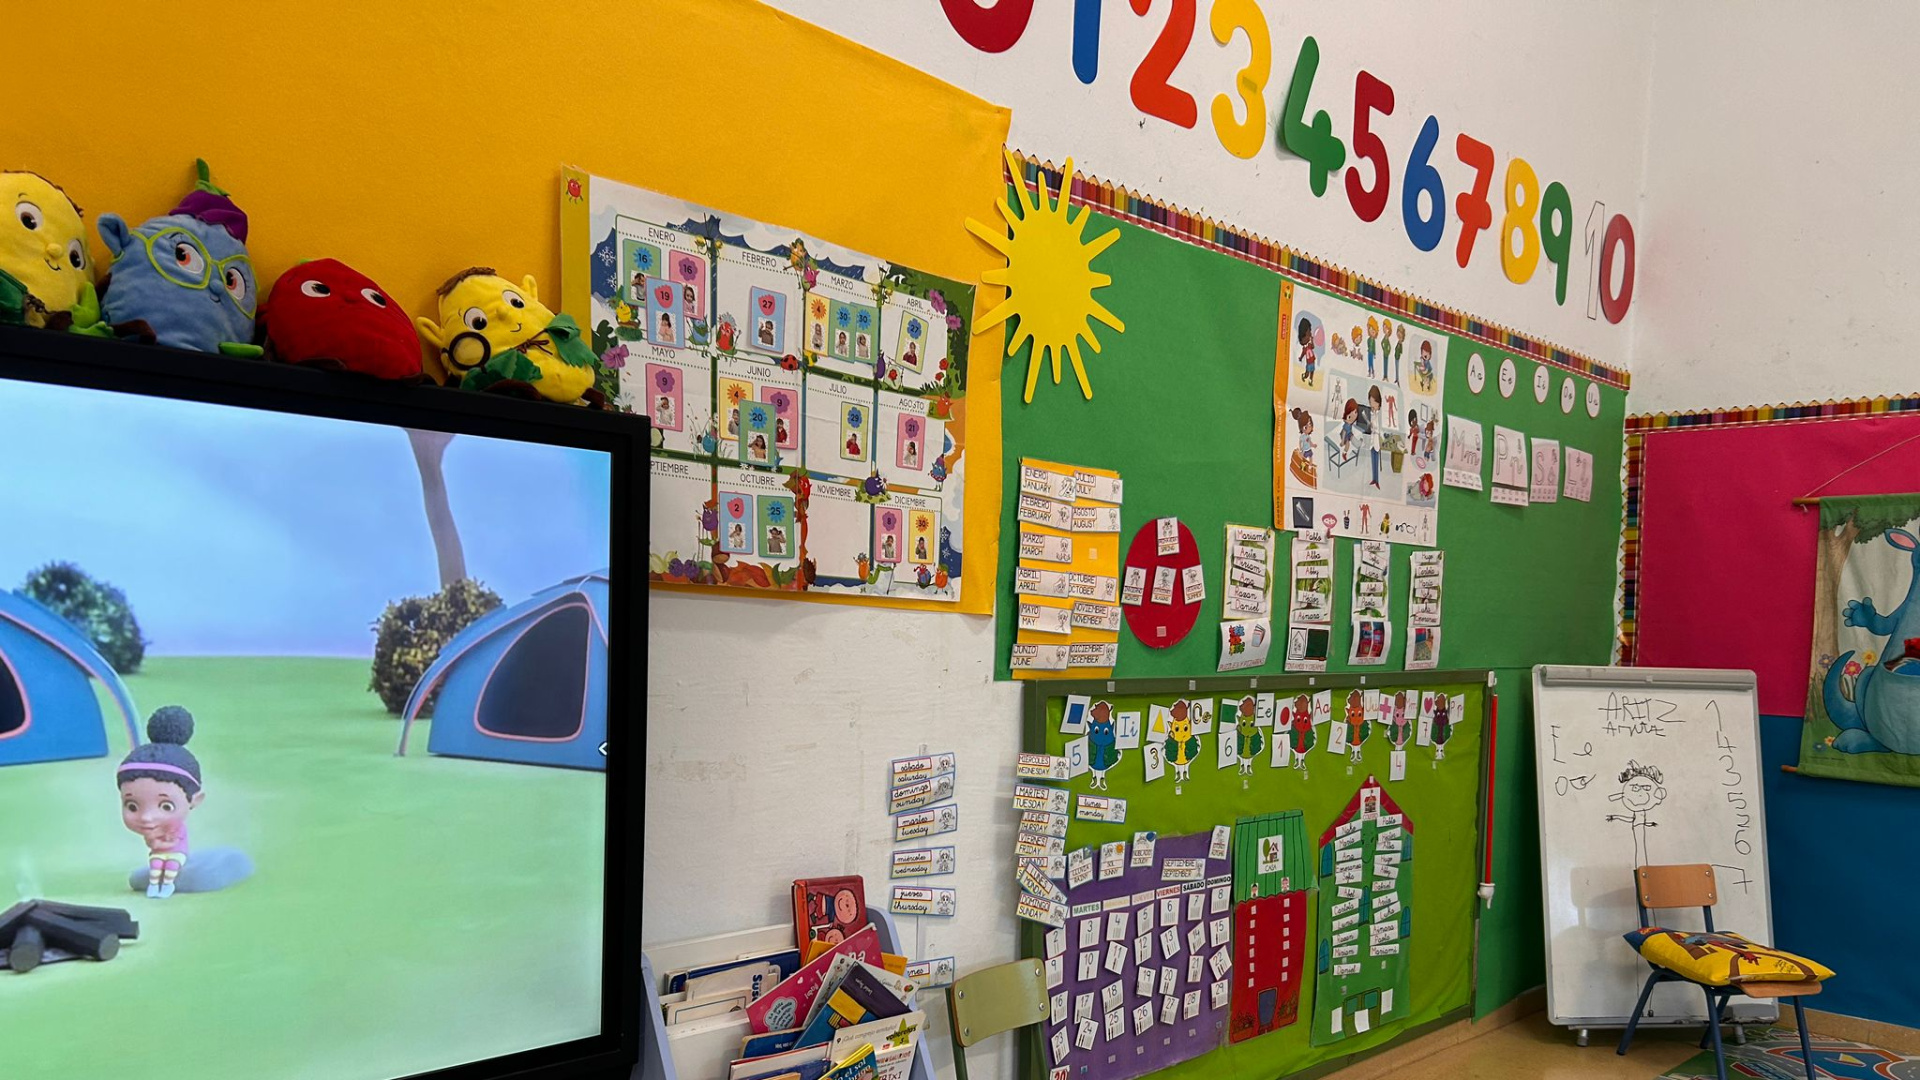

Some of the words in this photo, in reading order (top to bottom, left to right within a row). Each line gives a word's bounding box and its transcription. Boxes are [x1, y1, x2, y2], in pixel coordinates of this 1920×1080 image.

[1130, 0, 1198, 128] 2
[1210, 0, 1272, 158] 3
[1283, 36, 1346, 197] 4
[1345, 70, 1395, 222] 5
[1402, 115, 1446, 251] 6
[1455, 133, 1495, 267] 7
[1500, 157, 1540, 284] 8
[1540, 181, 1573, 305] 9
[1583, 200, 1635, 324] 10
[648, 228, 676, 243] ENERO
[637, 253, 649, 265] 16
[742, 251, 777, 268] FEBRERO
[682, 263, 694, 275] 16
[830, 276, 854, 290] MARZO
[660, 290, 671, 302] 19
[762, 299, 773, 311] 27
[906, 298, 924, 310] ABRIL
[815, 305, 822, 316] 4
[838, 311, 849, 323] 30
[858, 313, 868, 325] 30
[911, 323, 920, 334] 27
[651, 346, 676, 359] MAYO
[746, 366, 771, 378] JUNIO
[661, 376, 668, 387] 9
[734, 390, 740, 401] 4
[829, 384, 847, 395] JULIO
[776, 397, 783, 409] 9
[899, 398, 925, 411] AGOSTO
[752, 412, 763, 424] 20
[851, 413, 860, 424] 29
[907, 423, 916, 433] 21
[650, 461, 689, 476] PTIEMBRE
[740, 474, 775, 487] OCTUBRE
[1025, 469, 1047, 481] ENERO
[1075, 472, 1095, 483] JULIO
[817, 484, 852, 498] NOVIEMBRE
[1023, 480, 1051, 493] JANUARY
[1076, 484, 1092, 494] JULY
[894, 495, 926, 508] DICIEMBRE
[1021, 496, 1049, 510] FEBRERO
[734, 502, 740, 514] 2
[770, 505, 781, 517] 25
[1074, 508, 1096, 517] AGOSTO
[1020, 508, 1051, 521] FEBRUARY
[886, 516, 892, 527] 8
[916, 518, 927, 529] 30
[1073, 520, 1095, 529] AUGUST
[1023, 534, 1044, 545] MARZO
[1306, 530, 1321, 542] Pablo
[1022, 547, 1043, 556] MARCH
[1018, 570, 1039, 580] ABRIL
[1069, 574, 1095, 584] OCTUBRE
[1018, 582, 1037, 592] APRIL
[1069, 586, 1094, 595] OCTOBER
[1021, 605, 1039, 615] MAYO
[1074, 603, 1107, 615] NOVIEMBRE
[1235, 599, 1260, 612] Daniel
[1022, 617, 1036, 626] MAY
[1072, 615, 1102, 625] NOVEMBER
[1014, 646, 1037, 655] JUNIO
[1070, 645, 1104, 654] DICIEMBRE
[1013, 656, 1031, 666] JUNE
[1069, 656, 1099, 664] DECEMBER
[1257, 699, 1273, 719] Ee
[1314, 698, 1330, 715] Aa
[1598, 692, 1687, 722] ARITZ
[1121, 716, 1138, 737] Ii
[1421, 721, 1428, 738] 7
[1335, 726, 1343, 745] 2
[1225, 737, 1232, 757] 6
[1716, 731, 1737, 753] 4
[1277, 739, 1283, 758] 1
[1072, 744, 1081, 767] 5
[1150, 747, 1160, 770] 3
[1018, 766, 1050, 776] WEDNESDAY
[1719, 755, 1742, 787] 3
[897, 773, 928, 783] saturday
[894, 783, 929, 798] domingo
[1019, 787, 1046, 797] MARTES
[1016, 797, 1046, 808] TUESDAY
[1727, 792, 1747, 810] 5
[902, 816, 928, 826] martes
[902, 826, 929, 836] tuesday
[1735, 830, 1751, 855] 6
[1019, 845, 1042, 855] FRIDAY
[895, 864, 928, 874] wednesday
[1163, 869, 1192, 878] SEPTEMBER
[1711, 864, 1753, 894] 7
[900, 890, 923, 900] jueves
[1073, 904, 1100, 914] MARTES
[1156, 886, 1180, 898] VIERNES
[1207, 875, 1232, 886] DOMINGO
[894, 901, 928, 914] thursday
[1018, 904, 1043, 920] SUNDAY
[1053, 931, 1059, 943] 2
[1087, 921, 1093, 932] 3
[1115, 915, 1120, 925] 4
[1143, 909, 1148, 920] 5
[1167, 902, 1173, 912] 6
[1194, 896, 1199, 906] 7
[1218, 889, 1224, 899] 8
[1051, 959, 1057, 971] 9
[1084, 954, 1094, 965] 10
[1113, 944, 1122, 957] 11
[1139, 937, 1148, 949] 12
[1165, 930, 1174, 942] 13
[1192, 929, 1200, 940] 14
[1215, 921, 1224, 932] 15
[1055, 996, 1063, 1008] 16
[1080, 996, 1090, 1007] 17
[1108, 985, 1117, 997] 18
[1142, 969, 1151, 981] 19
[1164, 969, 1173, 981] 20
[1192, 958, 1200, 969] 21
[1213, 952, 1223, 966] 22
[1055, 1033, 1064, 1046] 23
[1084, 1023, 1094, 1035] 24
[1109, 1013, 1119, 1026] 25
[1138, 1006, 1148, 1020] 26
[1166, 998, 1175, 1009] 27
[1187, 993, 1196, 1005] 28
[1215, 984, 1224, 995] 29
[854, 1057, 867, 1070] sol
